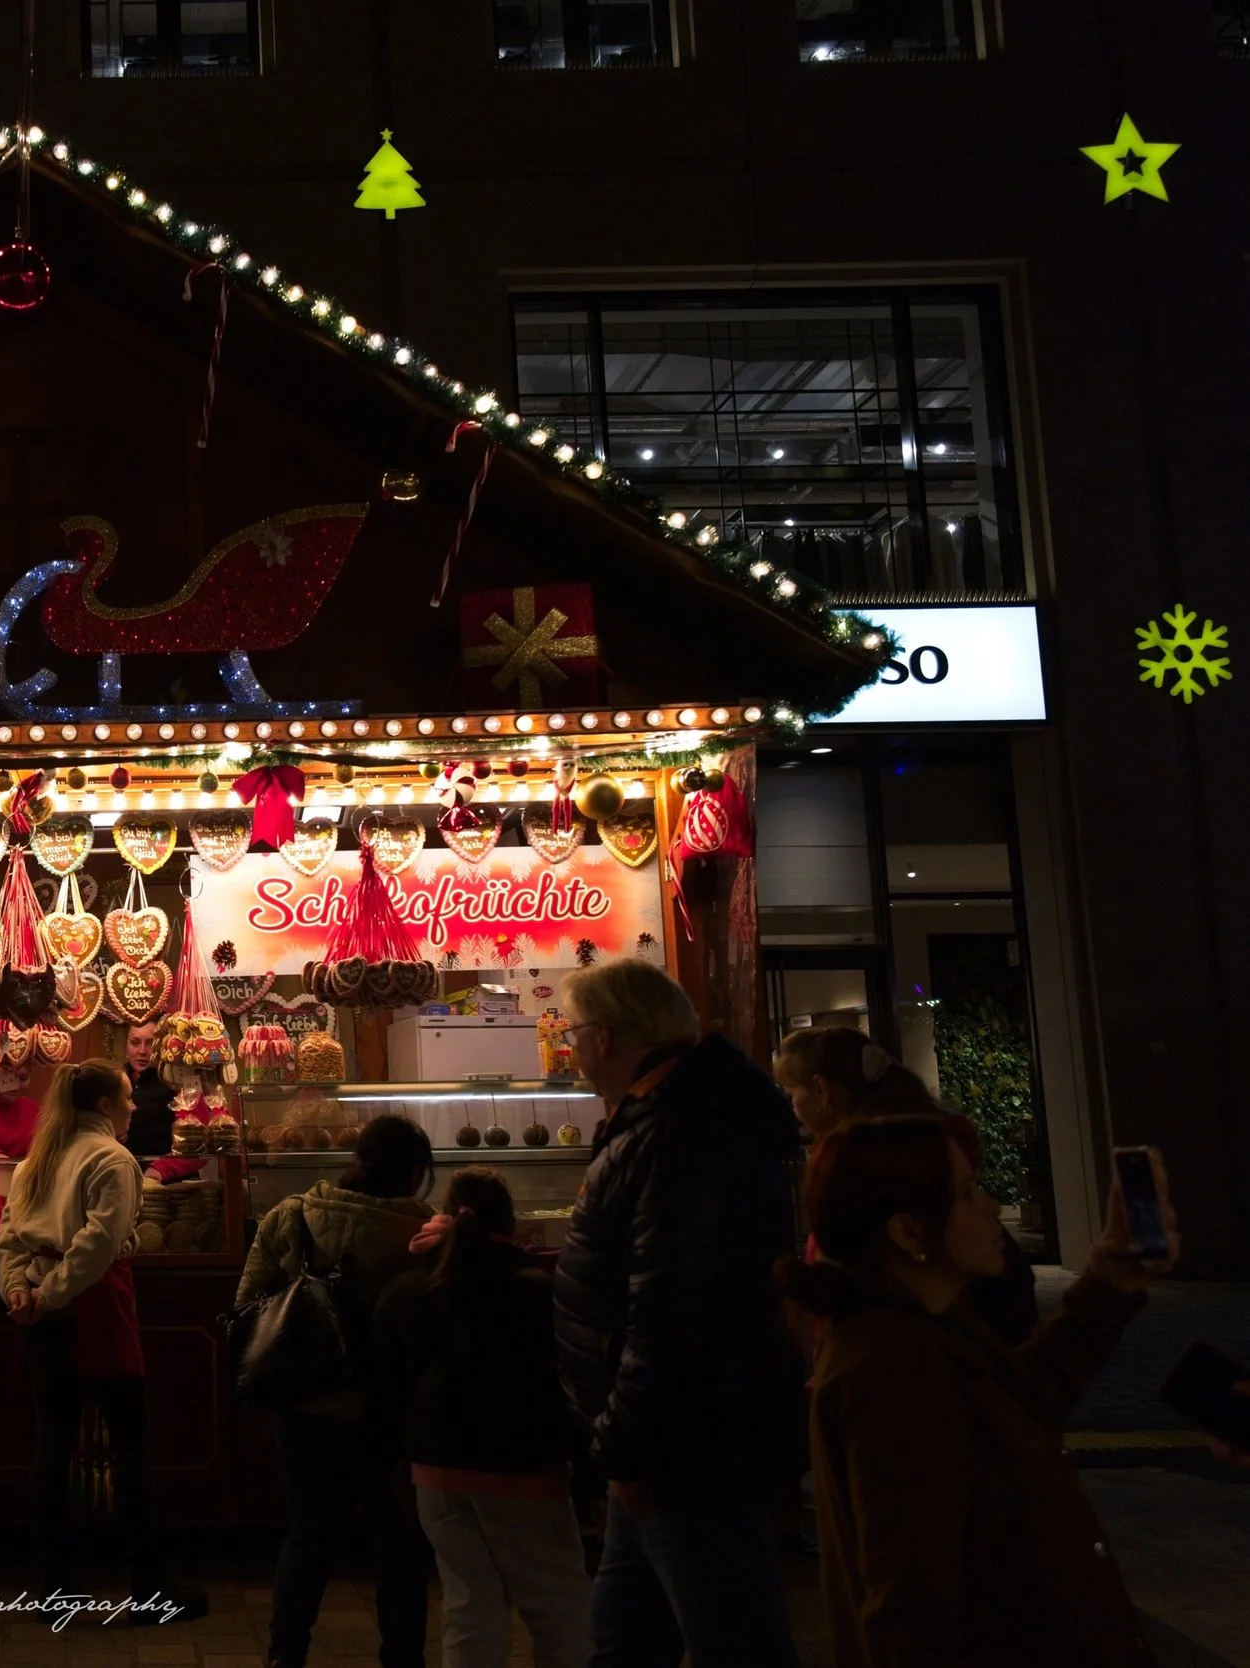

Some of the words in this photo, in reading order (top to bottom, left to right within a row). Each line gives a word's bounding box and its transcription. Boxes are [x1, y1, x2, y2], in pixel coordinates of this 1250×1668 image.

[54, 832, 74, 843] bist
[120, 825, 135, 840] Du
[135, 827, 152, 838] bist
[248, 870, 610, 947] Schkofrüchte
[117, 921, 138, 934] Ich
[119, 934, 145, 944] liebe
[124, 944, 150, 955] Dich
[127, 977, 148, 988] Ich
[124, 987, 154, 998] liebe
[215, 983, 253, 999] Dich
[126, 999, 151, 1010] Dich
